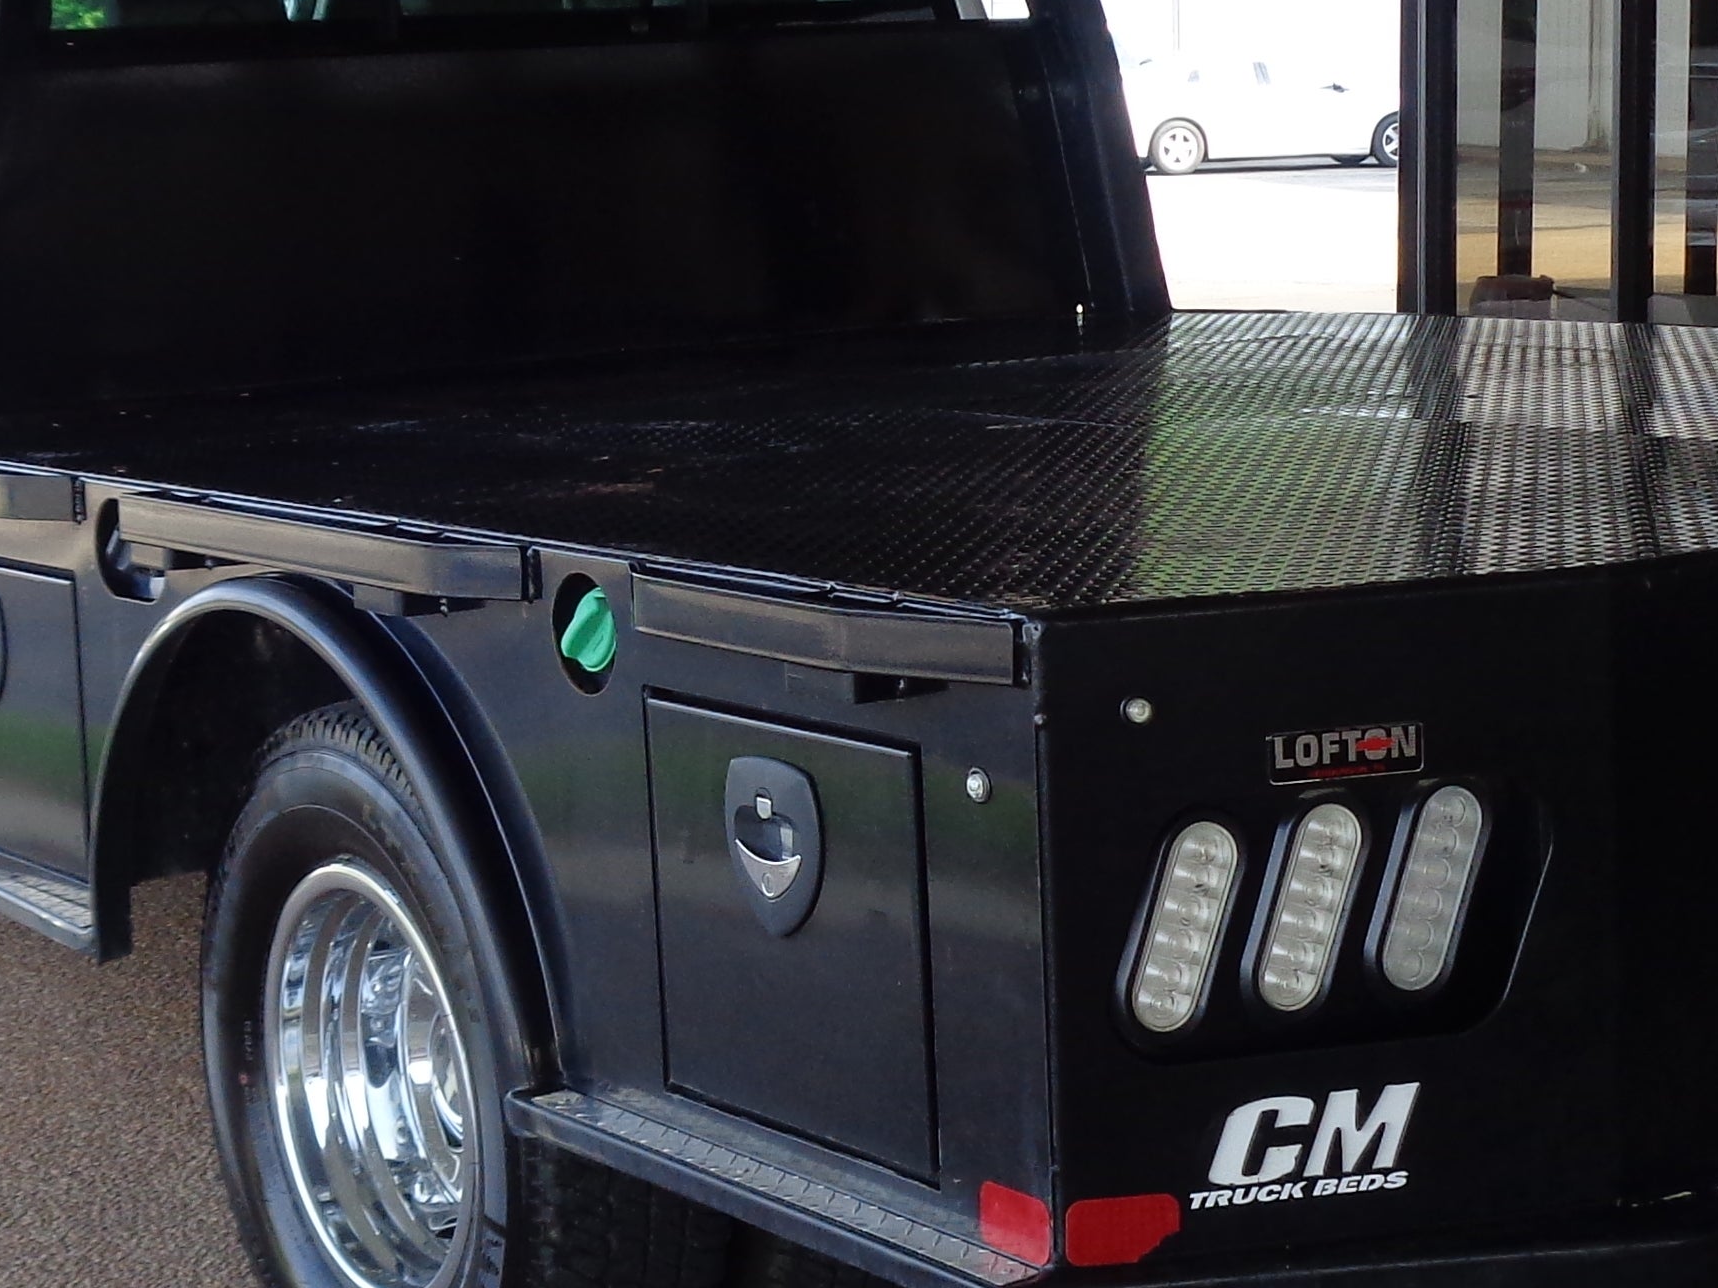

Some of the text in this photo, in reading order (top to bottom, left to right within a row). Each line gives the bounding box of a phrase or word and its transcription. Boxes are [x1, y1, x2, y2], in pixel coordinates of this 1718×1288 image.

[1273, 724, 1417, 769] LOFTON
[1207, 1082, 1421, 1187] CM
[1189, 1170, 1409, 1210] TRUCK BEDS
